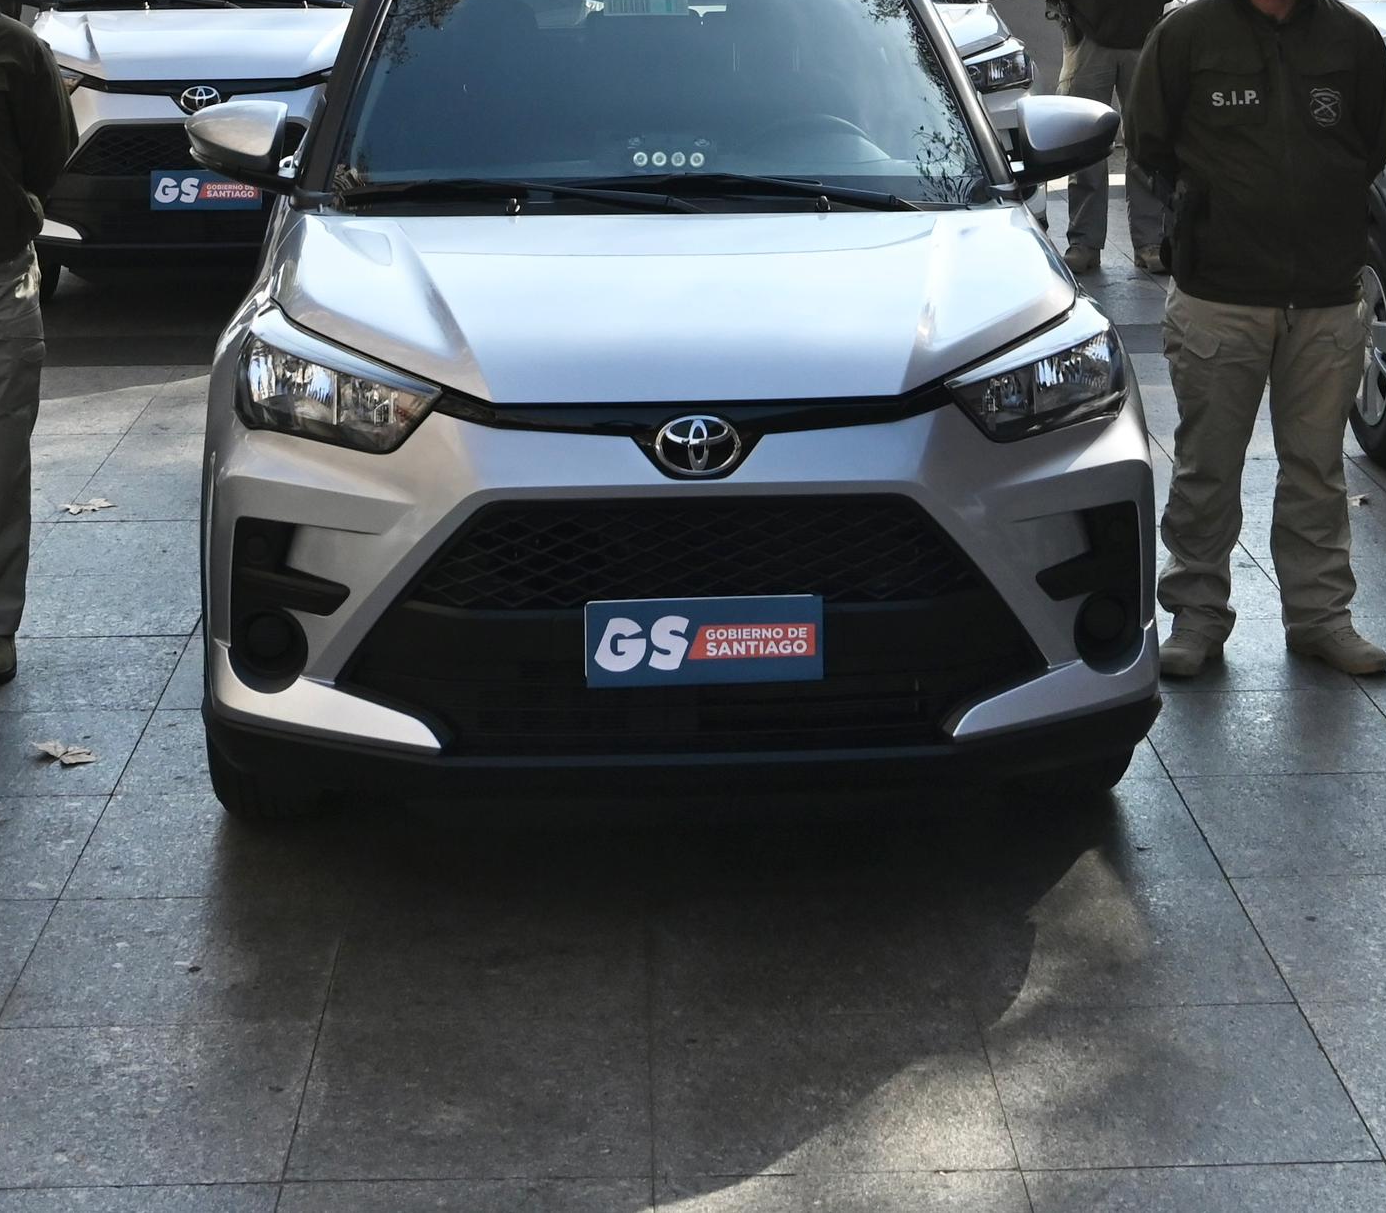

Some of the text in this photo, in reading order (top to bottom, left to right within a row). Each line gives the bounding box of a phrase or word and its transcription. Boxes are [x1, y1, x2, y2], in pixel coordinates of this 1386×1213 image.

[1211, 90, 1260, 107] S.I.P.
[154, 177, 199, 204] GS
[206, 190, 254, 198] SANTIAGO
[705, 627, 807, 641] GOBIERNO DE
[594, 615, 690, 673] GS
[706, 639, 808, 657] SANTIAGO
